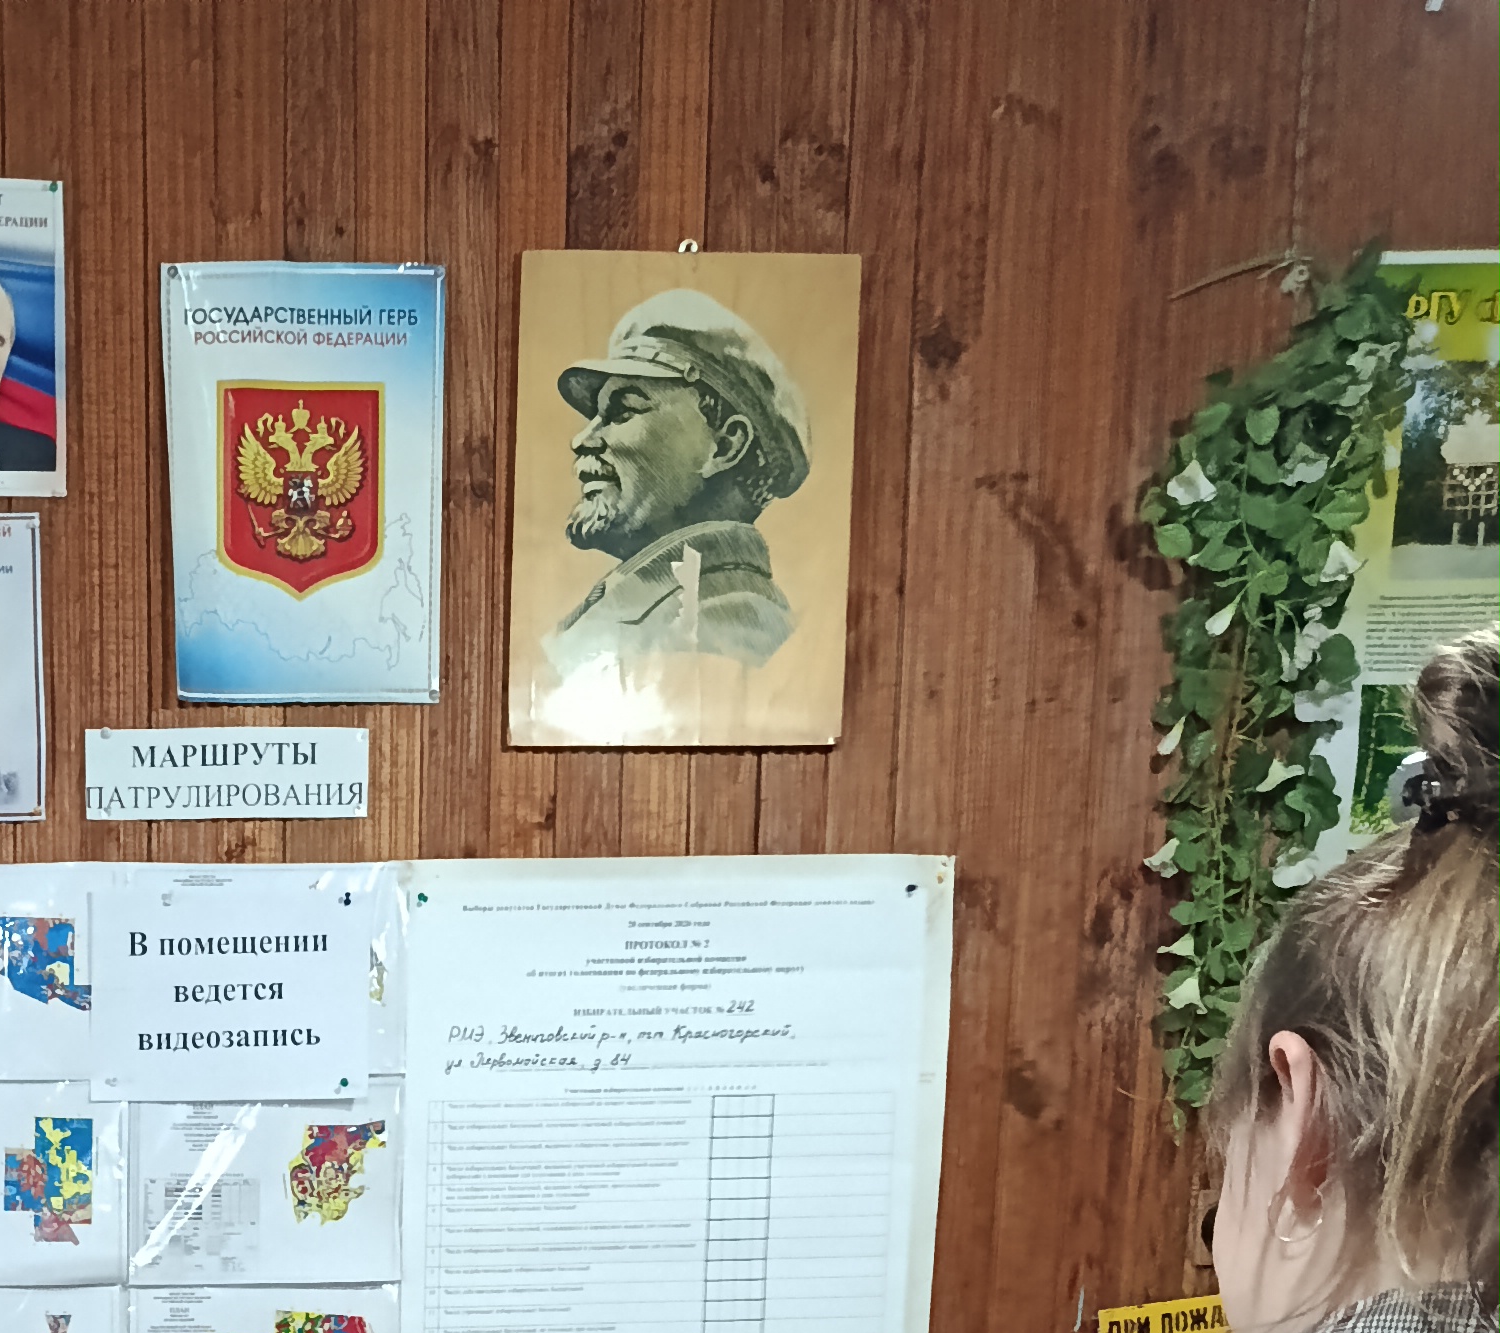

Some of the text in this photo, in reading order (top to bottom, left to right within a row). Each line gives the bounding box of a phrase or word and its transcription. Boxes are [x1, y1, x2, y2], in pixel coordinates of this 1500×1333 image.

[184, 304, 419, 326] ГОСУДАРСТВЕННЫЙ ГЕРБ
[194, 326, 408, 348] РОССИЙСКОЙ ФЕДЕРАЦИИ
[132, 742, 318, 769] МАРШРУТЫ
[86, 782, 364, 810] ПАТРУЛИРОВАНИЯ
[128, 931, 328, 957] В помещении
[625, 939, 688, 950] ПРОТОКОЛ
[173, 982, 284, 1005] ведется
[726, 999, 755, 1014] 242
[137, 1028, 321, 1053] видеозапись
